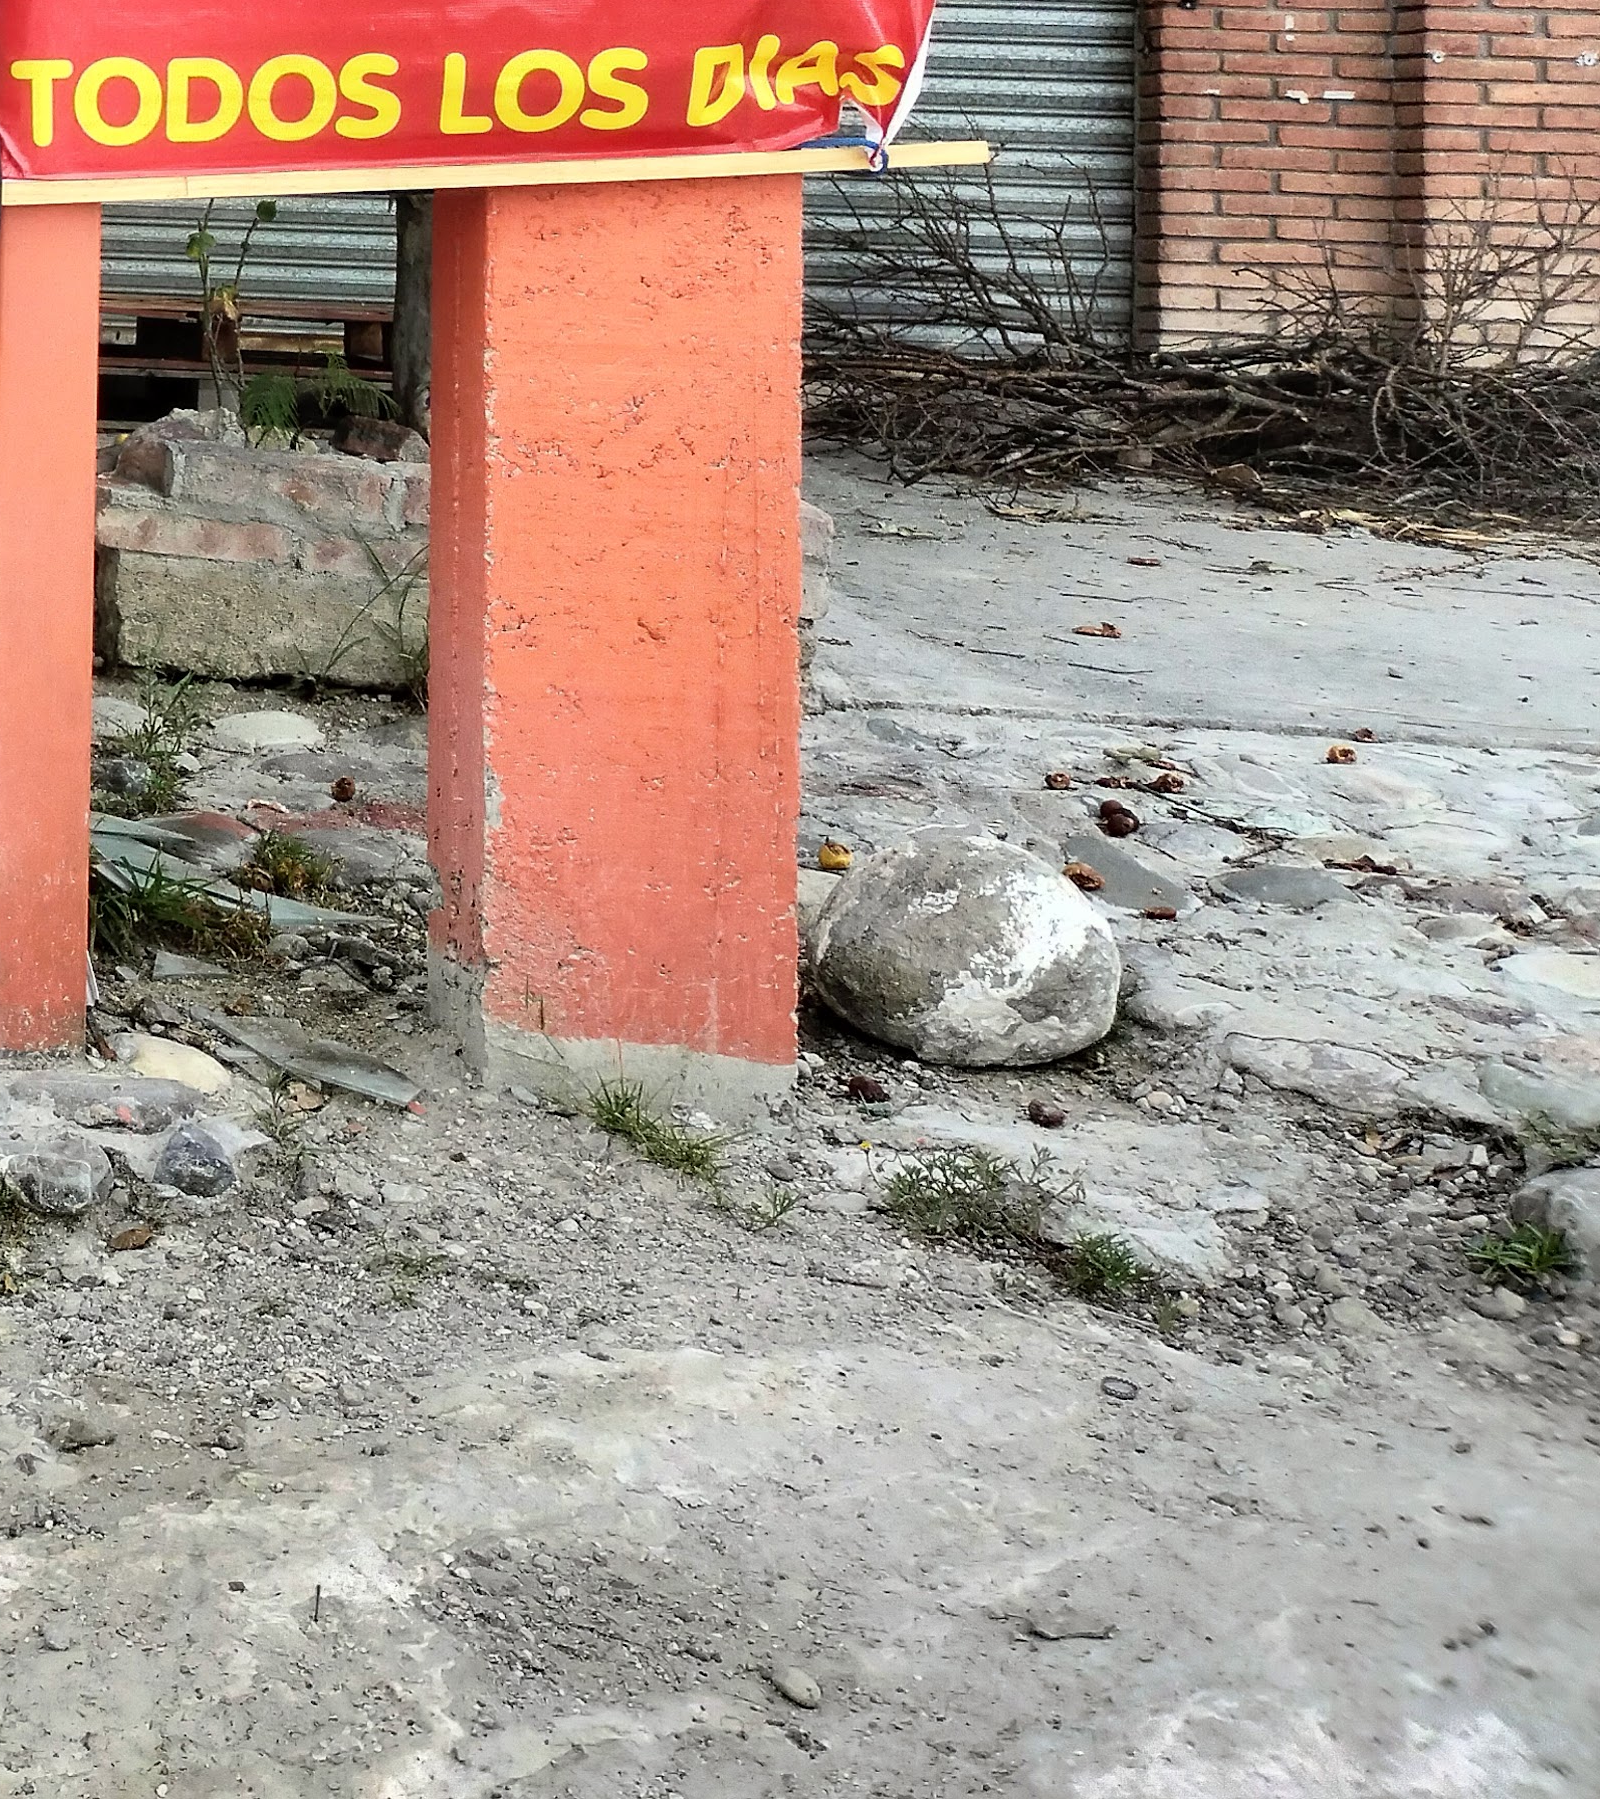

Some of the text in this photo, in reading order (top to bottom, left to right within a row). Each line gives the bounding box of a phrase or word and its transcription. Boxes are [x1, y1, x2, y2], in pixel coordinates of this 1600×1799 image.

[9, 33, 905, 148] TODOS LOS DIAS
